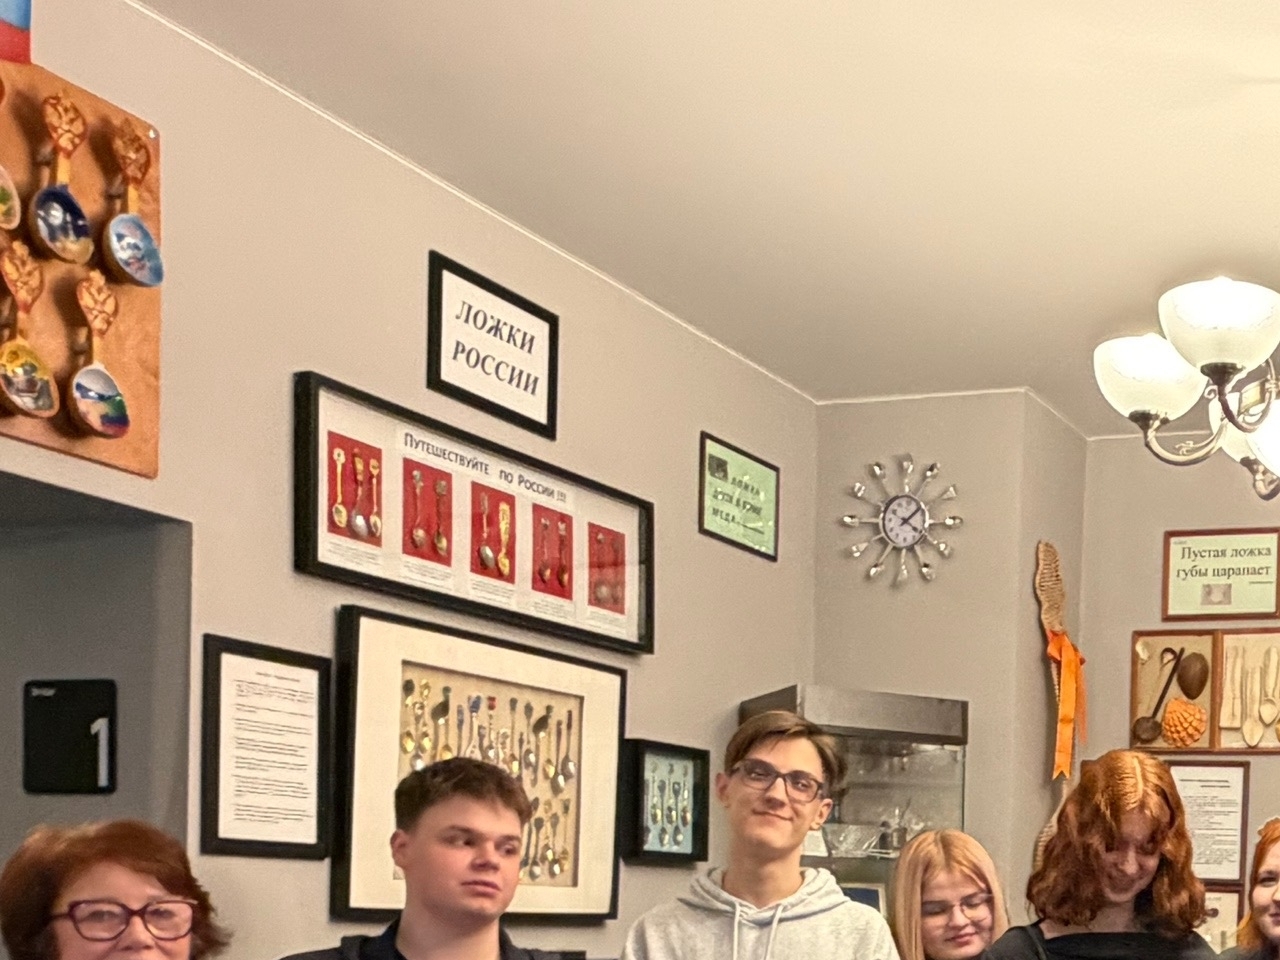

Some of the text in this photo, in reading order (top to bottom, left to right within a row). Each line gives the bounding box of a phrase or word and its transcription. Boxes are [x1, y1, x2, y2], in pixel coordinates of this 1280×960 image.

[455, 301, 536, 355] ЛОЖКИ
[452, 340, 540, 396] РОССИИ
[1176, 565, 1272, 581] губы царапает
[1181, 546, 1271, 562] Пустая ложка
[90, 717, 109, 787] 1
